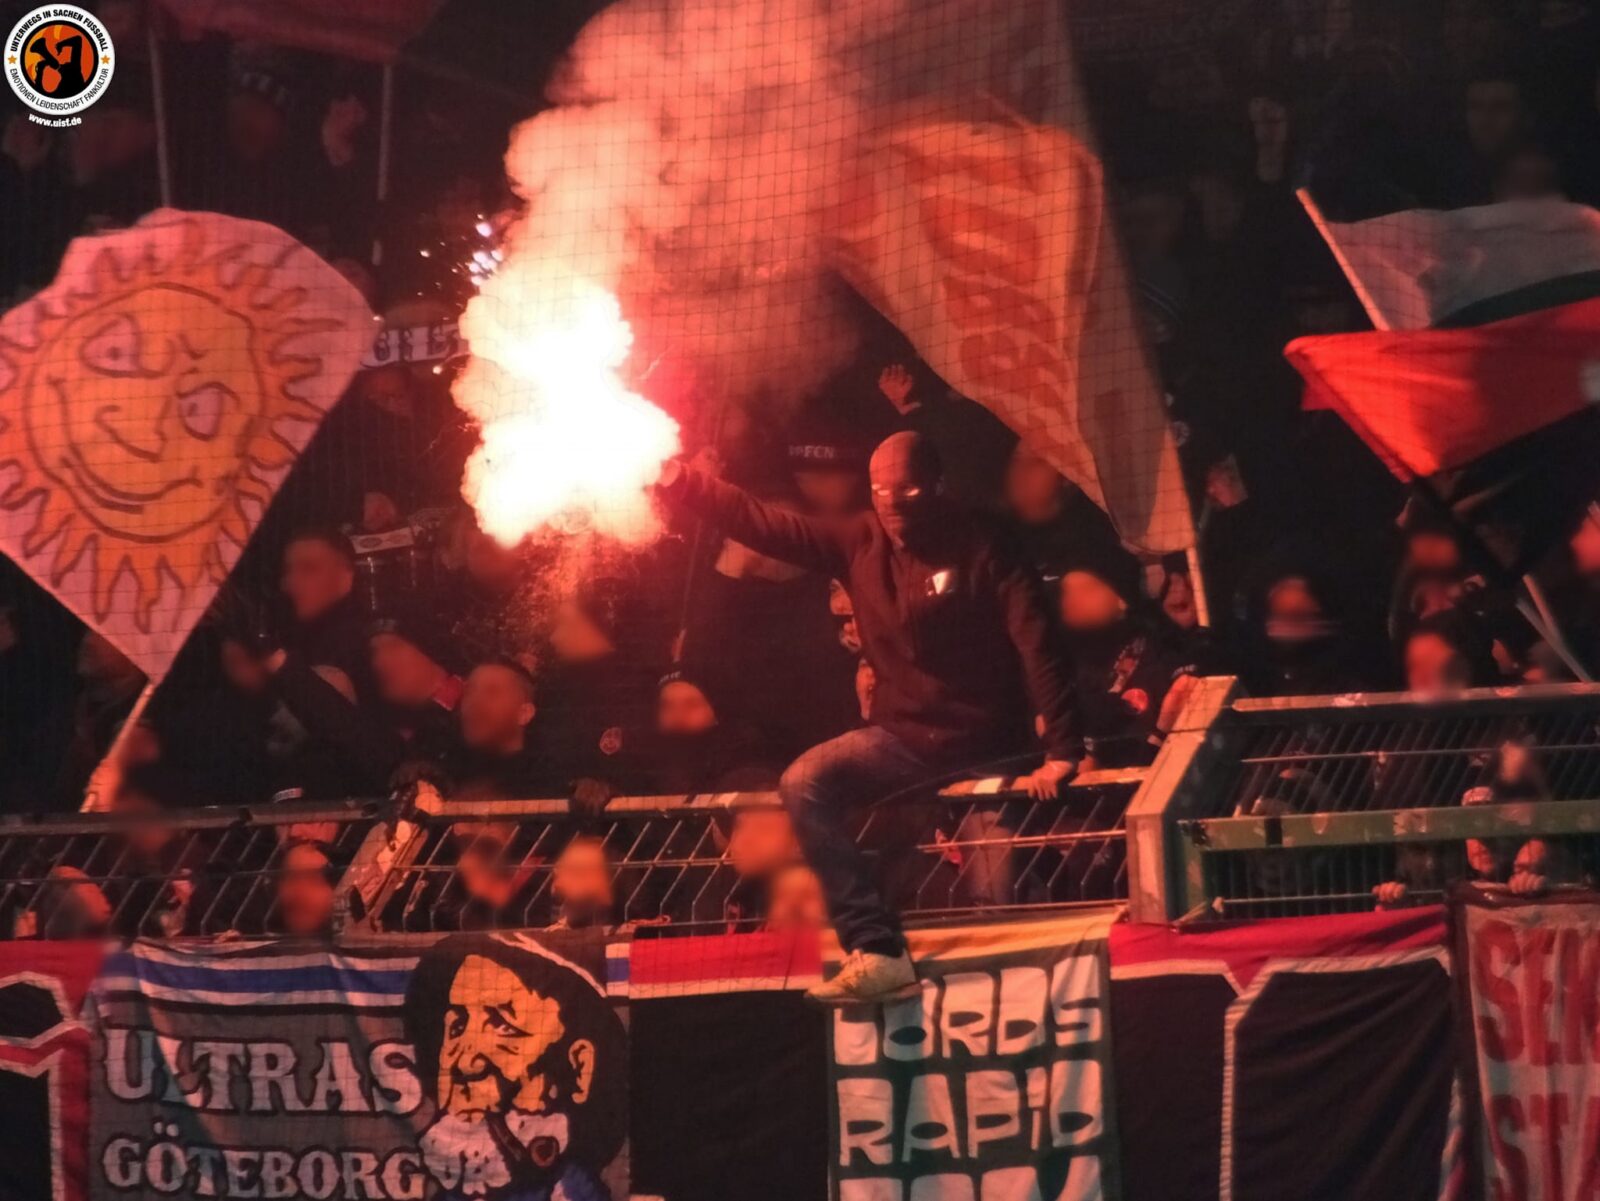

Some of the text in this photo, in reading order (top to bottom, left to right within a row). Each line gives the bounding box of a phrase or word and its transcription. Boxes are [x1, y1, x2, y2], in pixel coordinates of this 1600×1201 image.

[833, 954, 1102, 1066] LORDS
[104, 1029, 422, 1115] ULTRAS
[103, 1121, 424, 1199] GÖTEBORG
